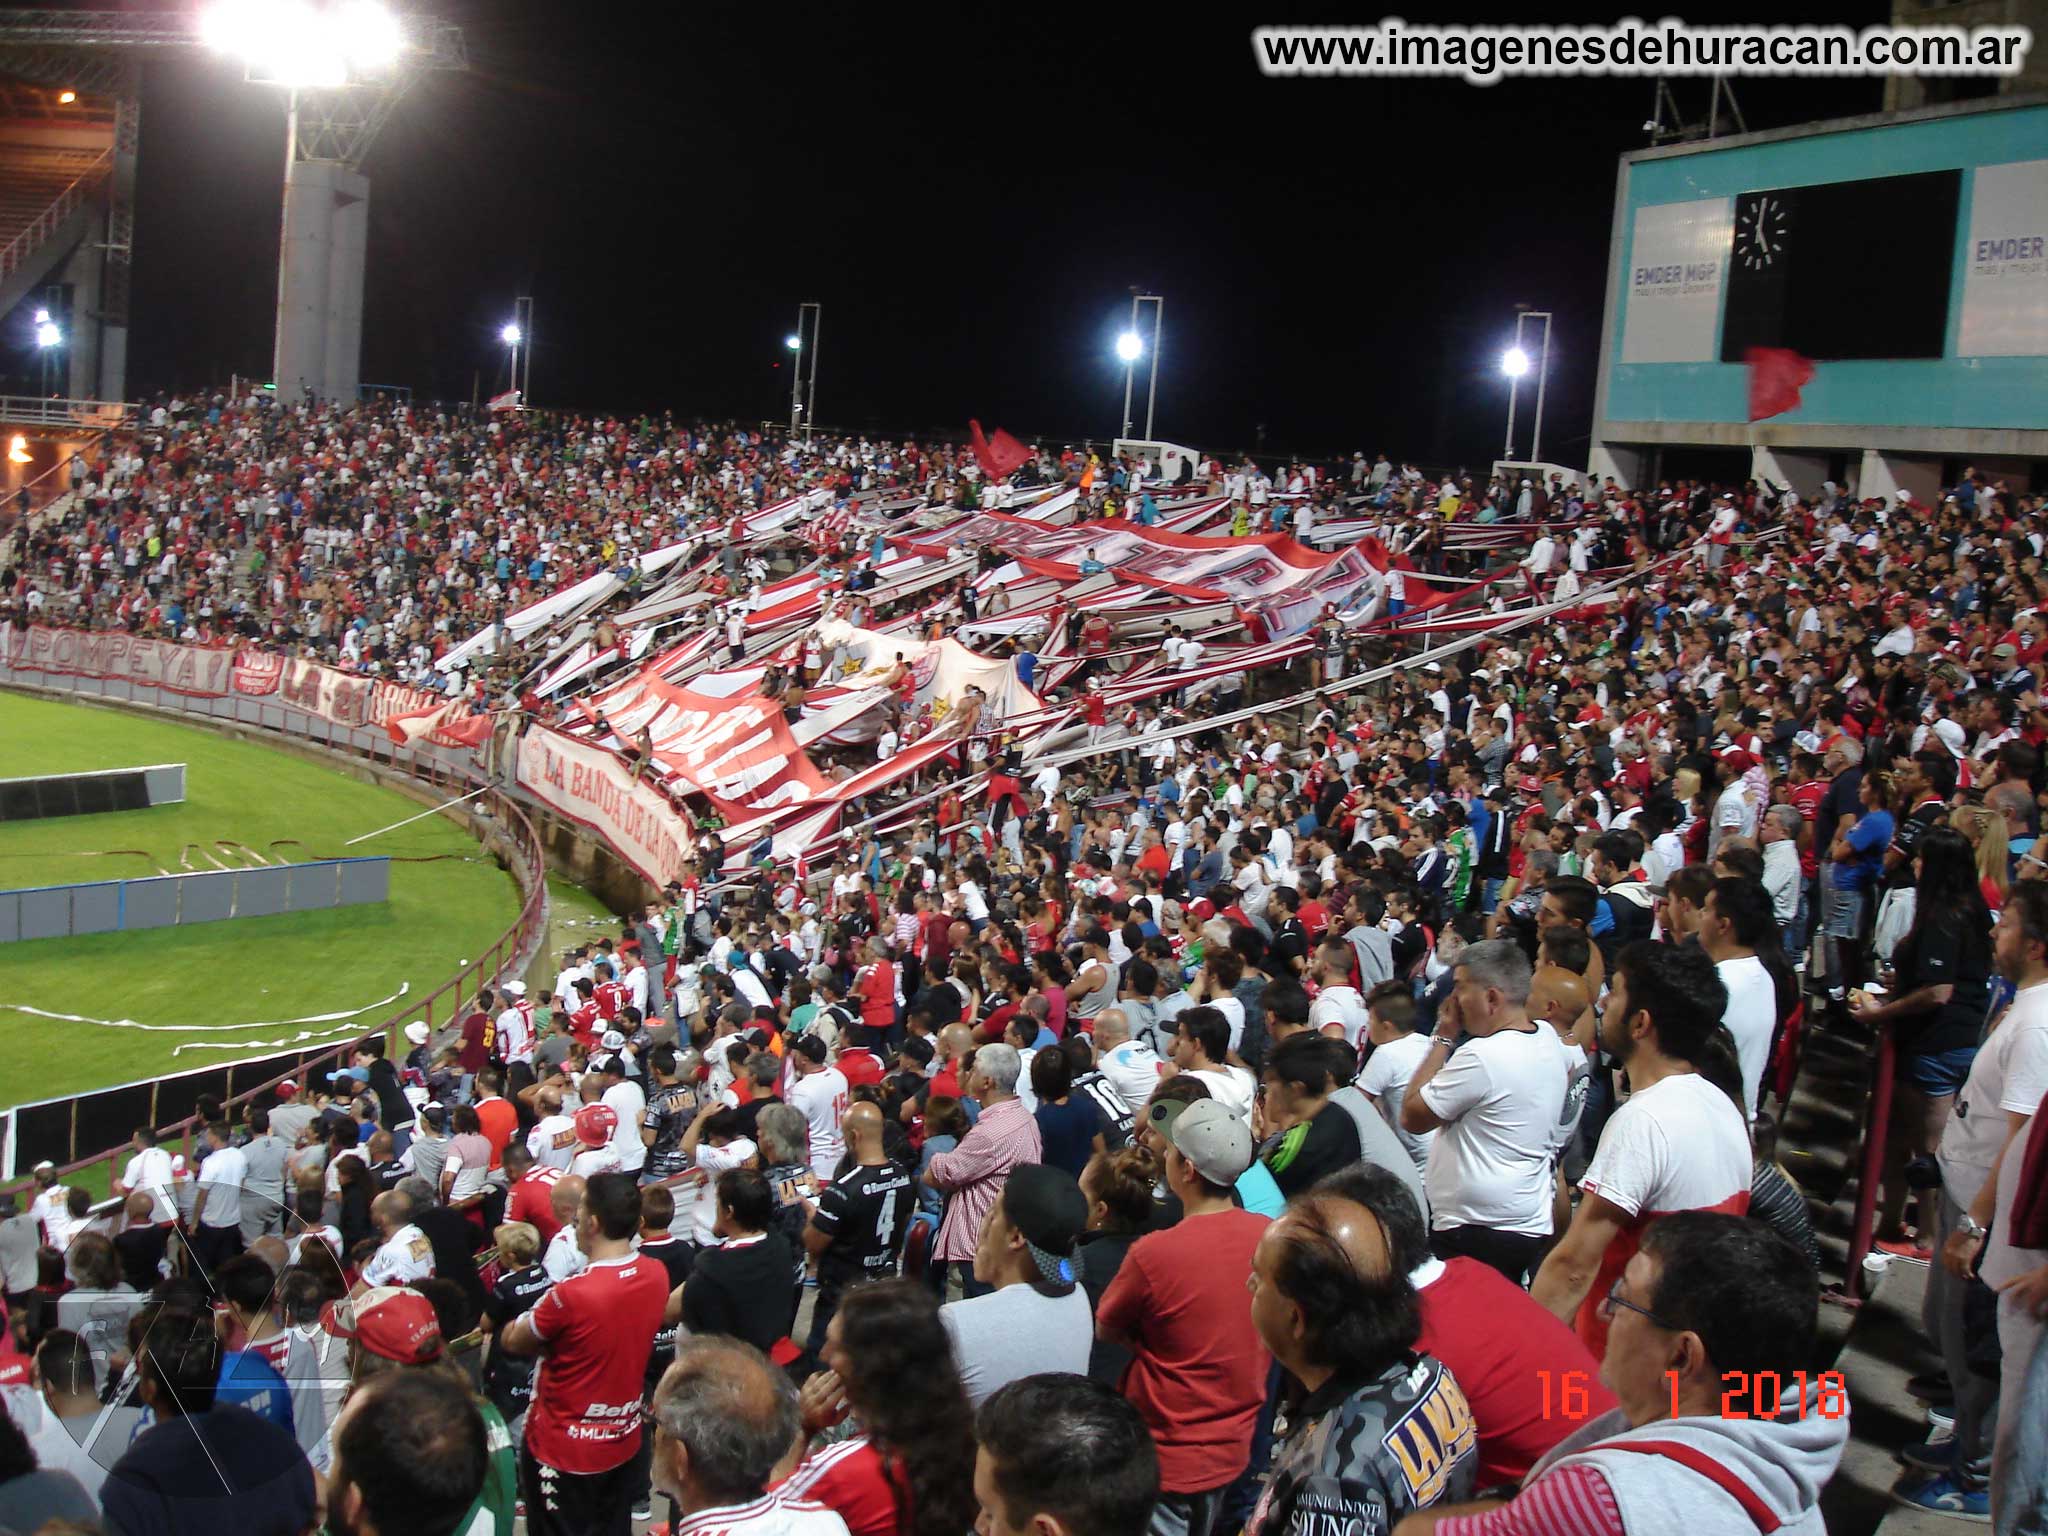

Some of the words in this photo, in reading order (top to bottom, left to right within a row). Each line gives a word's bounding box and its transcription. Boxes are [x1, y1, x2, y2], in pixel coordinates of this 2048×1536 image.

[1977, 236, 2044, 261] EMDER
[1635, 265, 1681, 286] EMDER
[544, 748, 565, 791] LA
[570, 760, 622, 829] BANDA
[624, 796, 645, 846] DE
[1083, 1079, 1132, 1121] 10
[876, 1189, 897, 1245] 4
